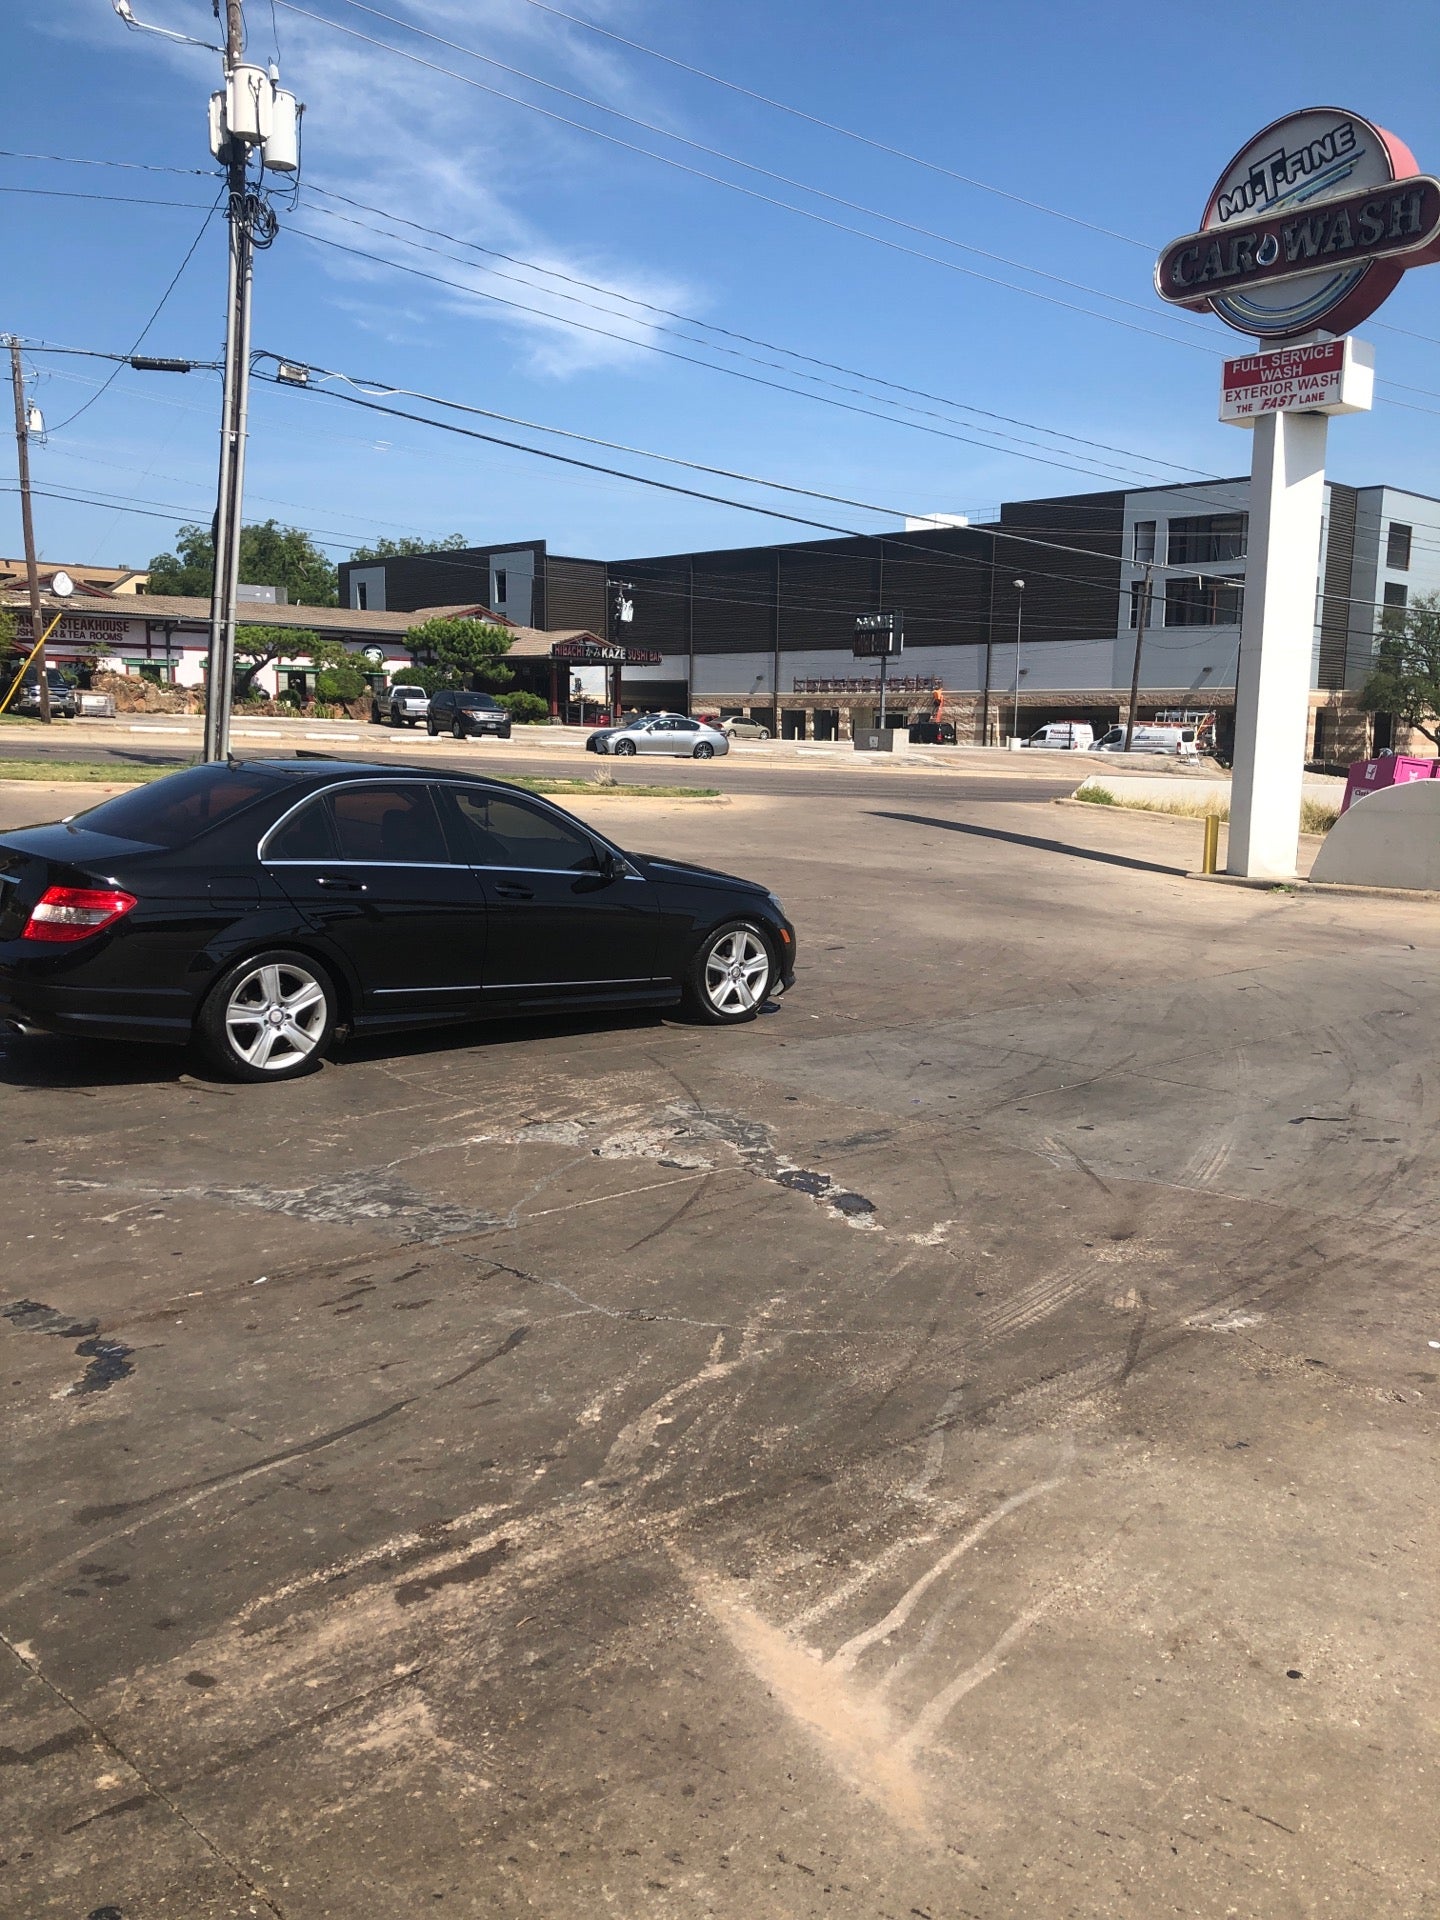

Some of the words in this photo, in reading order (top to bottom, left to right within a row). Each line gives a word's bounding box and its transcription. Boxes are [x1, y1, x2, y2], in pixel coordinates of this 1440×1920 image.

[1171, 232, 1257, 288] CAR
[1280, 189, 1425, 263] WASH
[1232, 358, 1267, 374] FULL
[1271, 344, 1335, 367] SERVICE
[1260, 364, 1303, 382] WASH
[1225, 381, 1293, 403] EXTERIOR
[1297, 372, 1340, 390] WASH
[1236, 403, 1253, 413] THE
[1260, 393, 1297, 410] FAST
[1299, 391, 1325, 404] LANE
[60, 618, 130, 633] STEAKHOUSE
[60, 629, 66, 638] &
[68, 630, 86, 640] TEA
[89, 631, 123, 641] ROOMS
[554, 645, 585, 657] HIBACHI
[601, 647, 626, 660] KAZE
[628, 648, 648, 661] SUSHI
[649, 650, 663, 662] BAR
